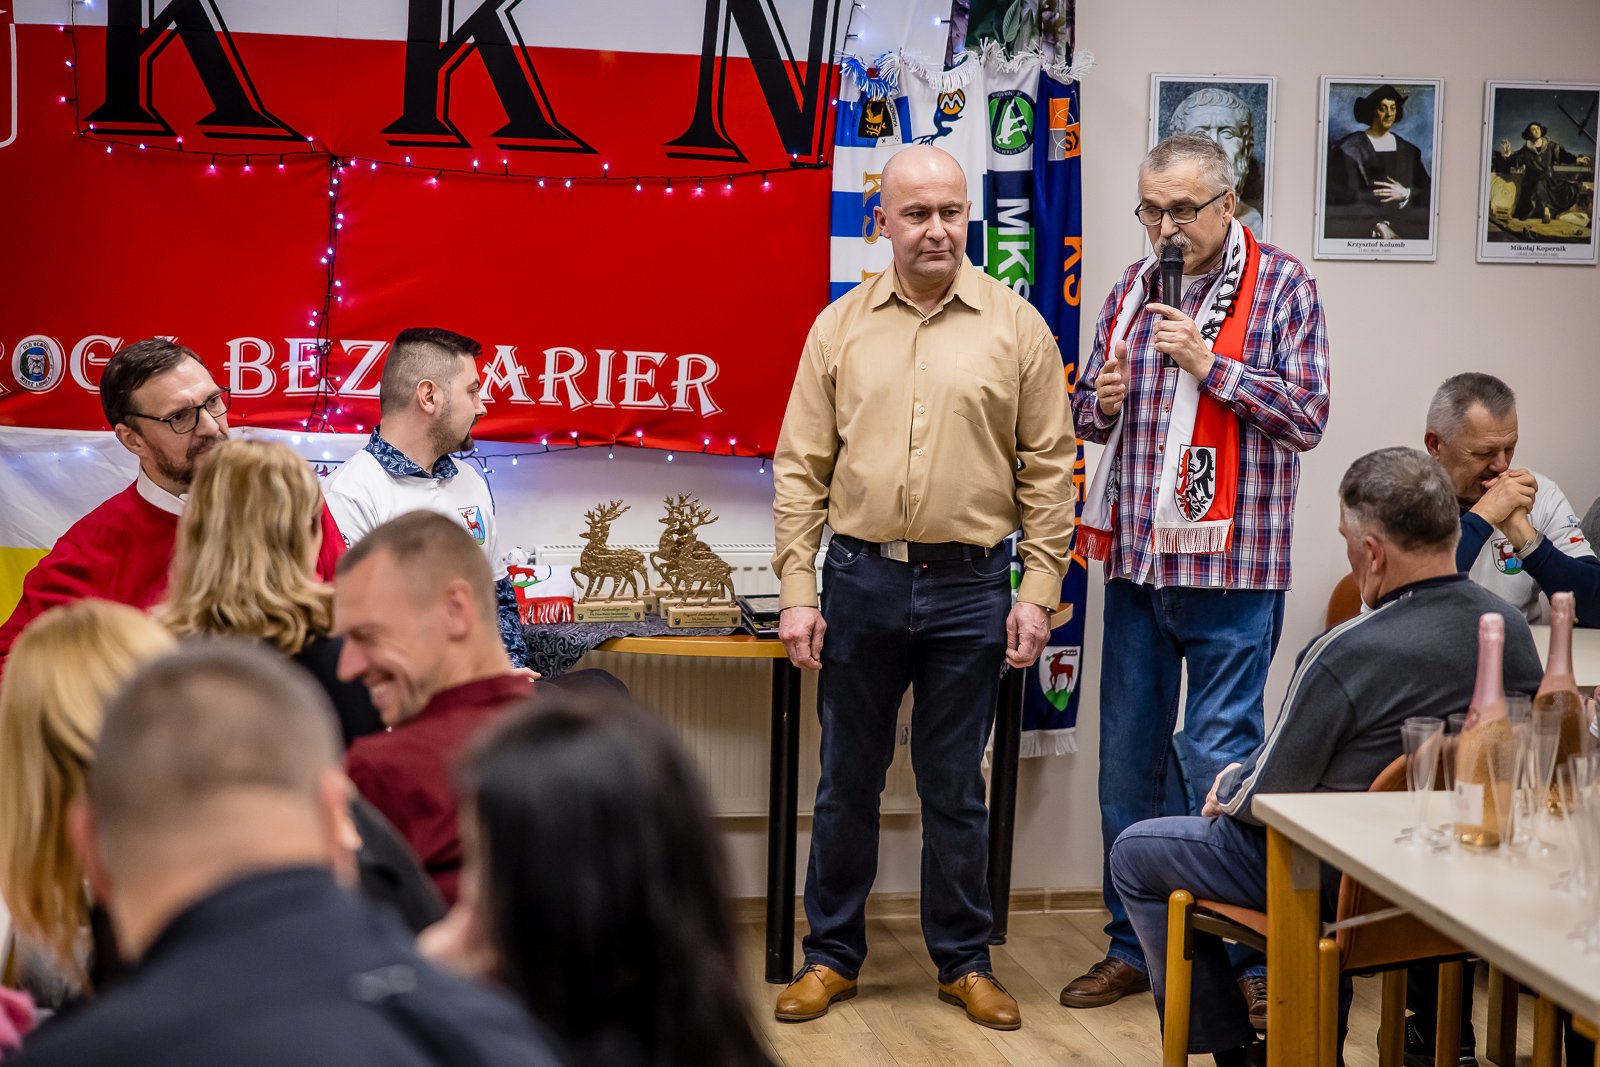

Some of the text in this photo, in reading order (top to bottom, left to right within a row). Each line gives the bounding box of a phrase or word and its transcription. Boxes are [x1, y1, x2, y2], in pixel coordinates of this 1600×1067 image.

[997, 198, 1030, 301] MKS
[1347, 241, 1378, 249] Krzysztof
[223, 337, 391, 399] BEZ
[478, 344, 723, 418] ARIER
